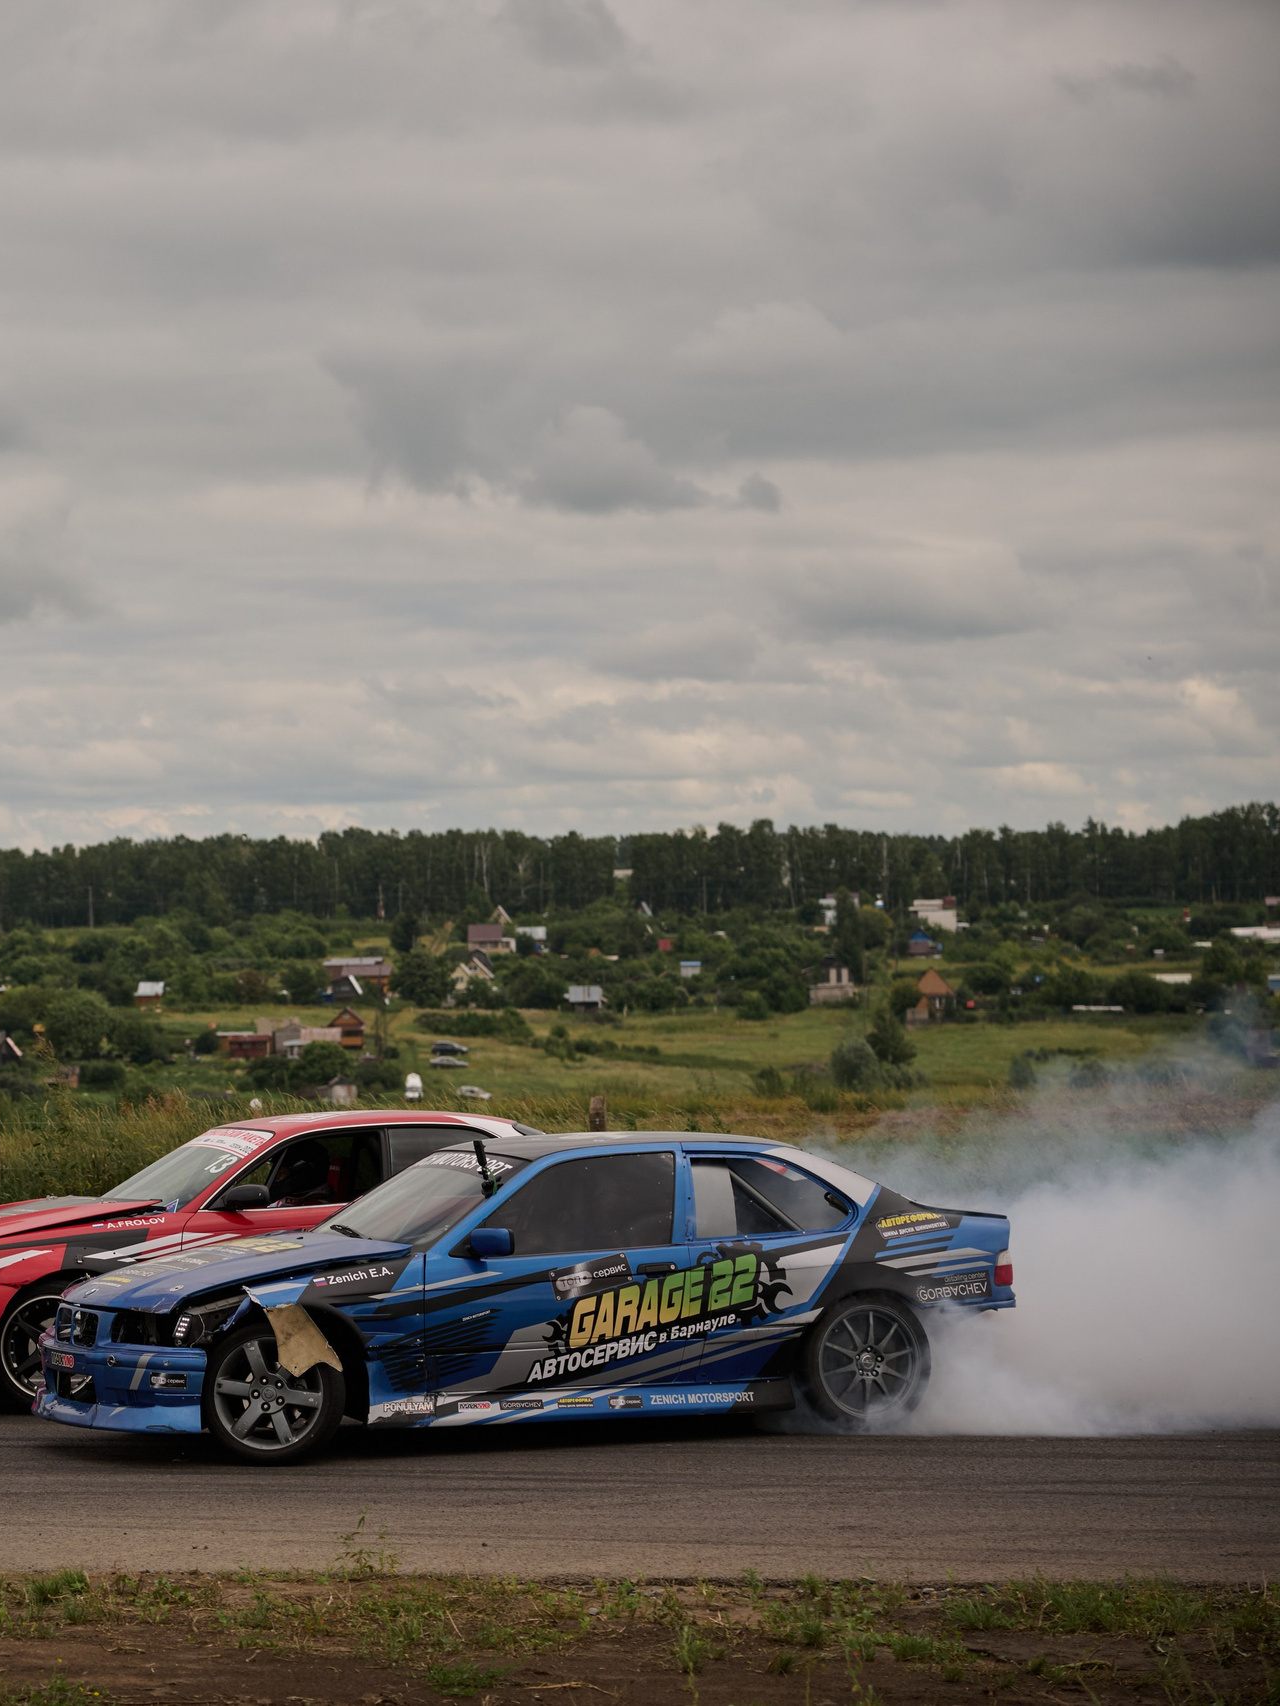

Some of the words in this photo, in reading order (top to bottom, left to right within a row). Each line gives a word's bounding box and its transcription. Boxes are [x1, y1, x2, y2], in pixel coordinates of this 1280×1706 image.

[204, 1153, 238, 1173] 13
[107, 1217, 165, 1229] A.FROLOV
[327, 1271, 368, 1285] Zenich
[369, 1266, 394, 1279] E.A.
[593, 1263, 627, 1279] сервис
[569, 1266, 705, 1349] GARAGE
[708, 1253, 757, 1311] 22
[527, 1331, 657, 1383] АВТОСЕРВИС
[659, 1333, 672, 1344] в
[670, 1313, 736, 1340] Барнауле
[459, 1402, 491, 1410] MAXMO
[650, 1394, 686, 1405] ZENICH
[688, 1391, 754, 1404] MOTORSPORT
[384, 1402, 433, 1412] PONULYAM
